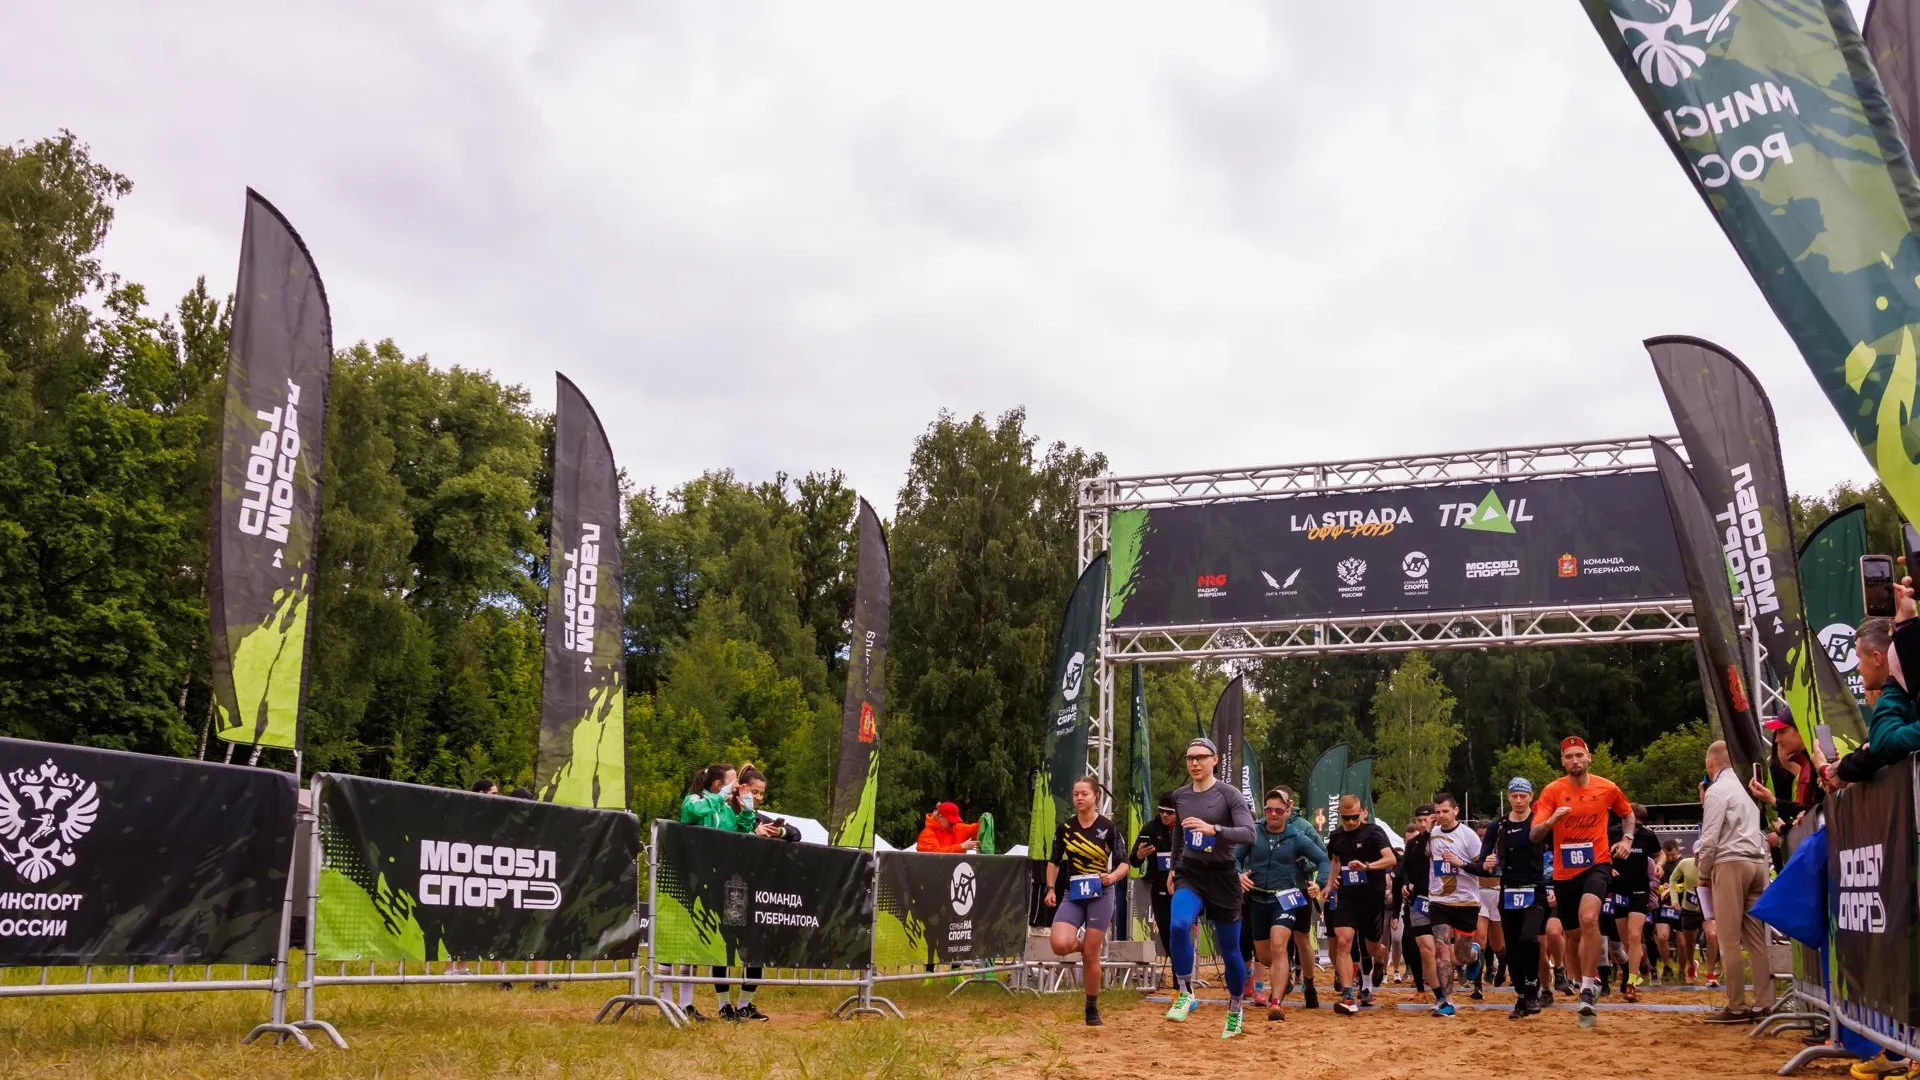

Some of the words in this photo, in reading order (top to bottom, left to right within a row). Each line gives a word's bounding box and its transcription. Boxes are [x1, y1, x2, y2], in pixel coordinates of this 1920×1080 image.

[1466, 560, 1517, 570] МОСОБЛ
[1584, 557, 1624, 565] КОМАНДА
[1466, 569, 1507, 578] СПОРТ
[1584, 566, 1640, 574] ГУБЕРНАТОРА
[1192, 831, 1203, 846] 18
[420, 840, 556, 879] МОСОБЛ
[1570, 850, 1584, 864] 66
[1440, 862, 1450, 873] 40
[419, 874, 529, 909] СПОРТ
[1080, 881, 1090, 896] 14
[0, 892, 82, 910] ИНСПОРТ
[755, 890, 803, 908] КОМАНДА
[1288, 894, 1298, 905] 11
[1513, 893, 1525, 906] 57
[755, 911, 819, 927] ГУБЕРНАТОРА
[963, 920, 972, 930] НА
[0, 918, 67, 936] ОССИИ
[948, 930, 972, 941] СПОРТЕ
